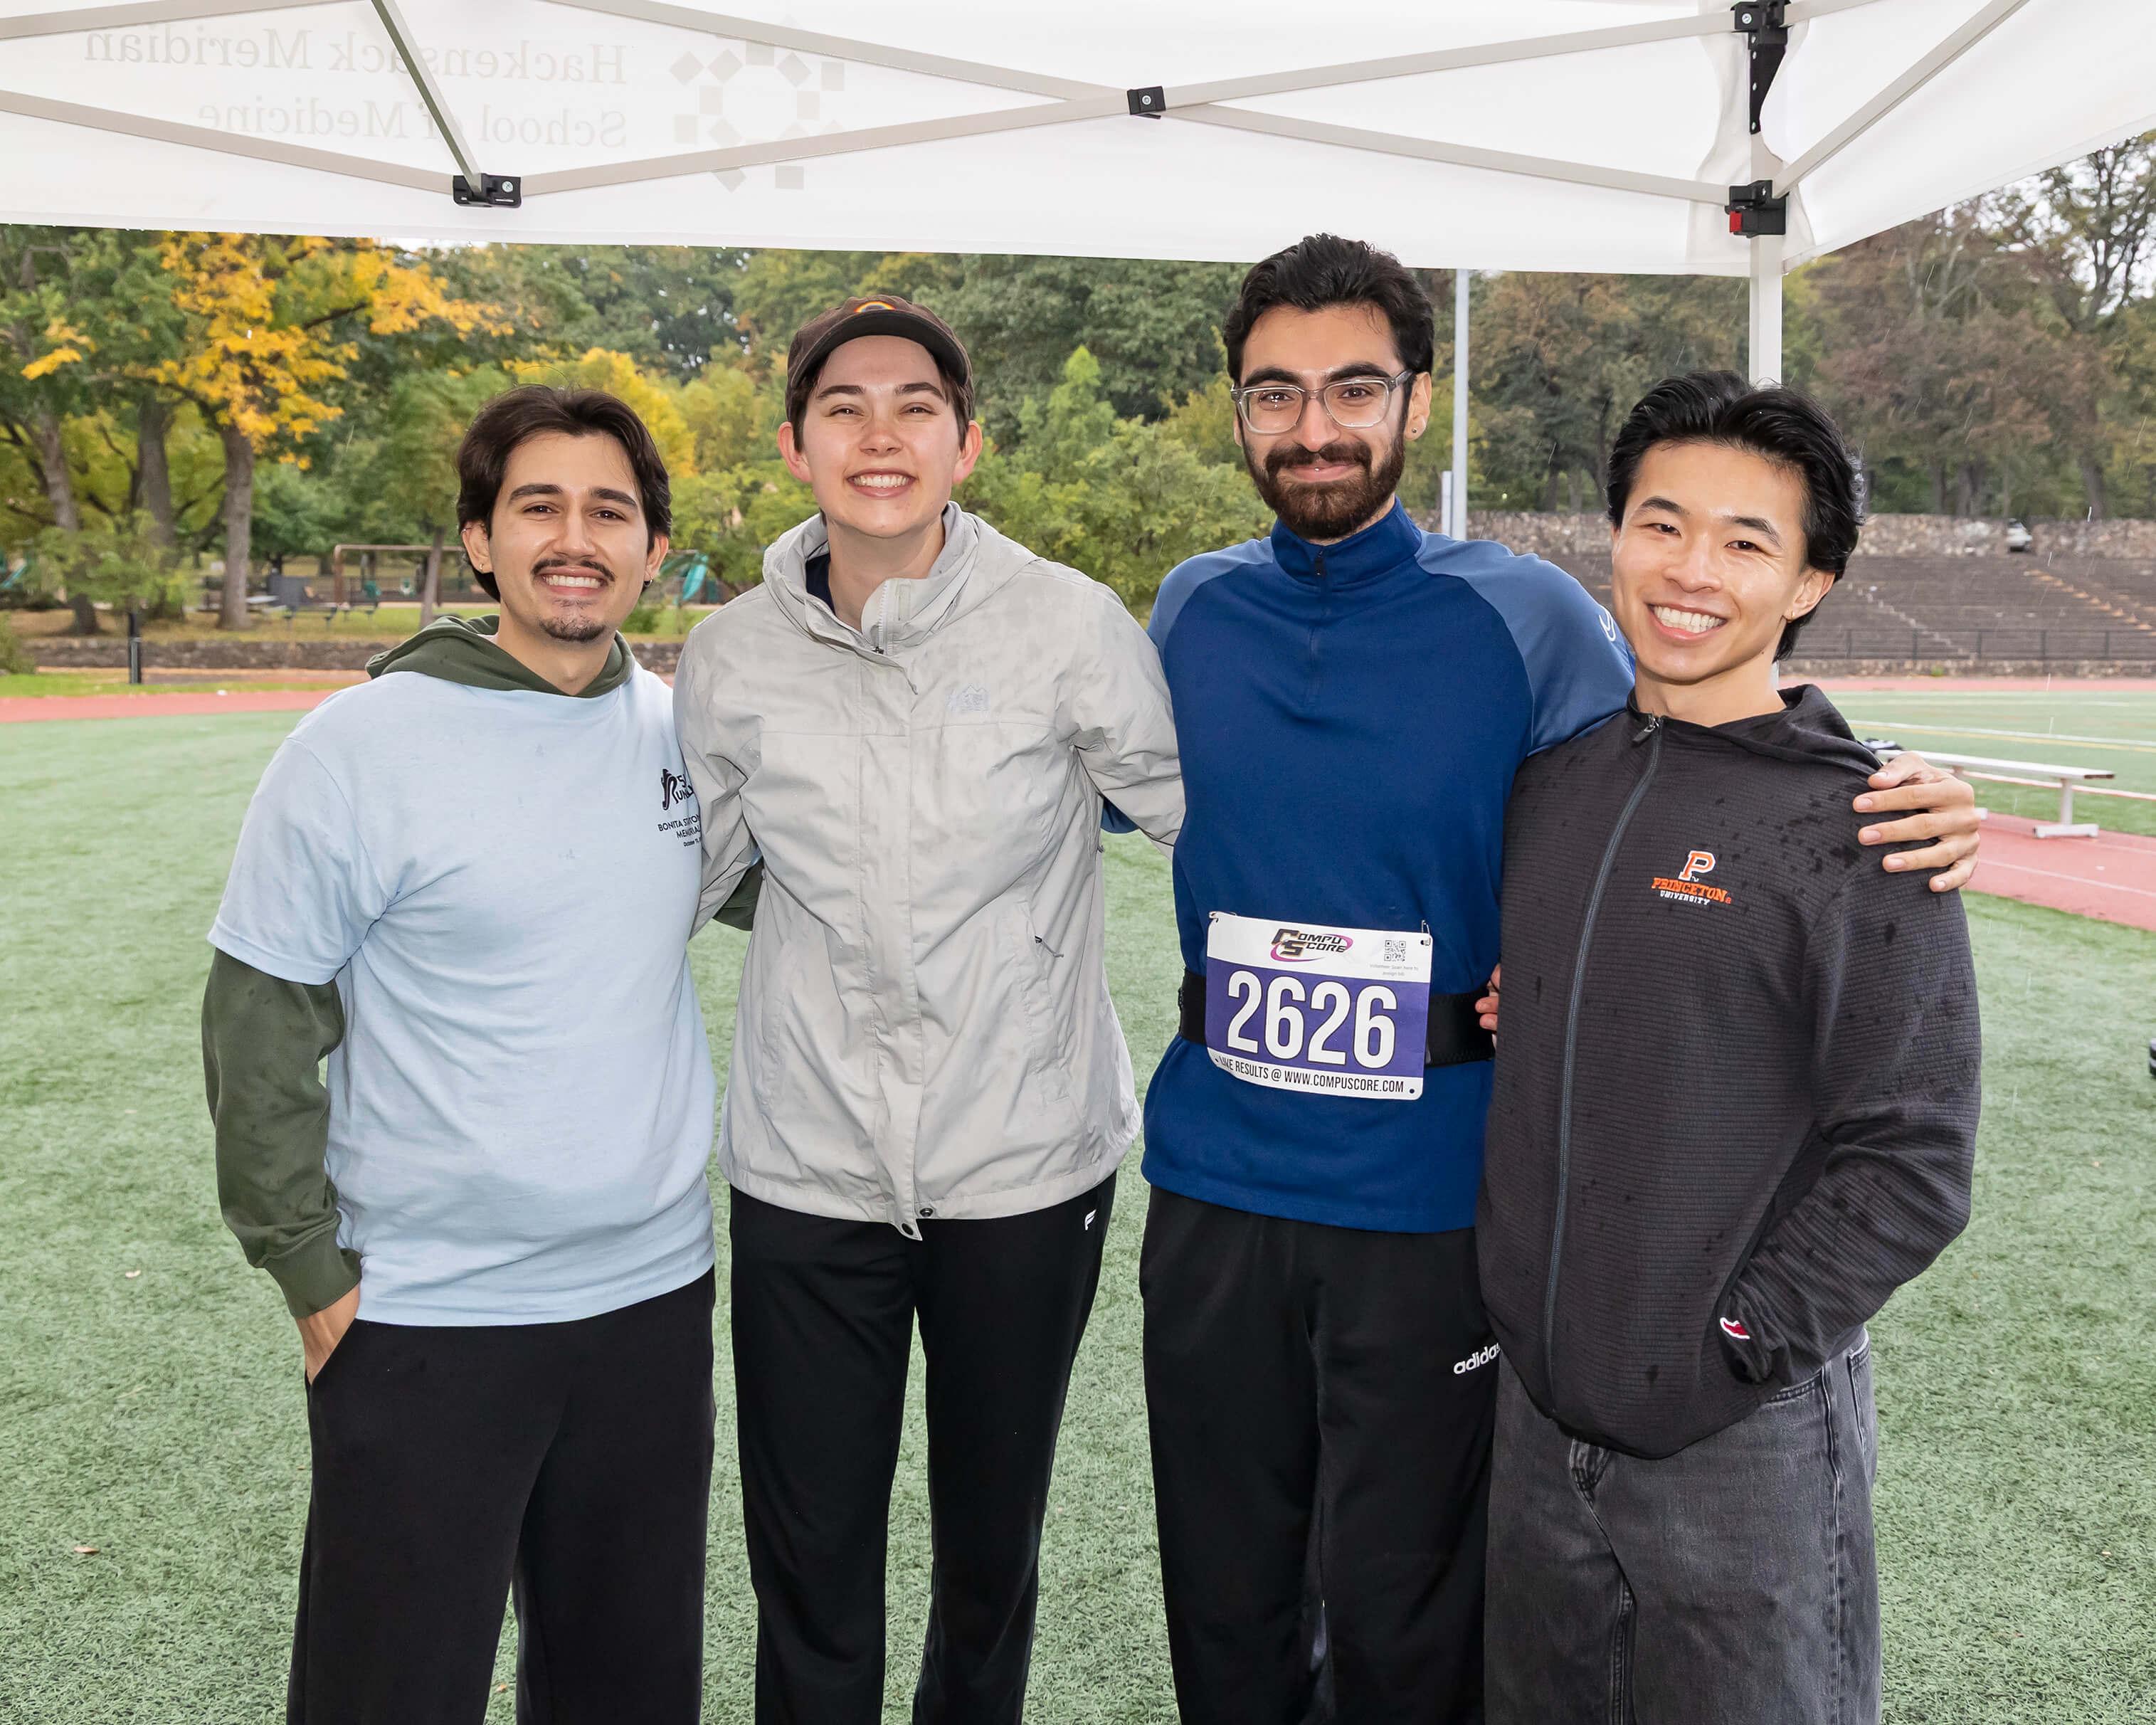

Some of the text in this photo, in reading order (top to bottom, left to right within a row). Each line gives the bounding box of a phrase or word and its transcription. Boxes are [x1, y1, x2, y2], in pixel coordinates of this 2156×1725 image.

[657, 820, 683, 832] BONITA
[1678, 850, 1716, 881] P
[1652, 877, 1728, 902] PRINCETON
[1659, 890, 1711, 906] UNIVERSITY
[1227, 970, 1397, 1069] 2626
[1235, 1060, 1269, 1080] RESULTS
[1271, 1068, 1282, 1082] @
[1284, 1070, 1404, 1093] WWW.COMPUSCORE.COM
